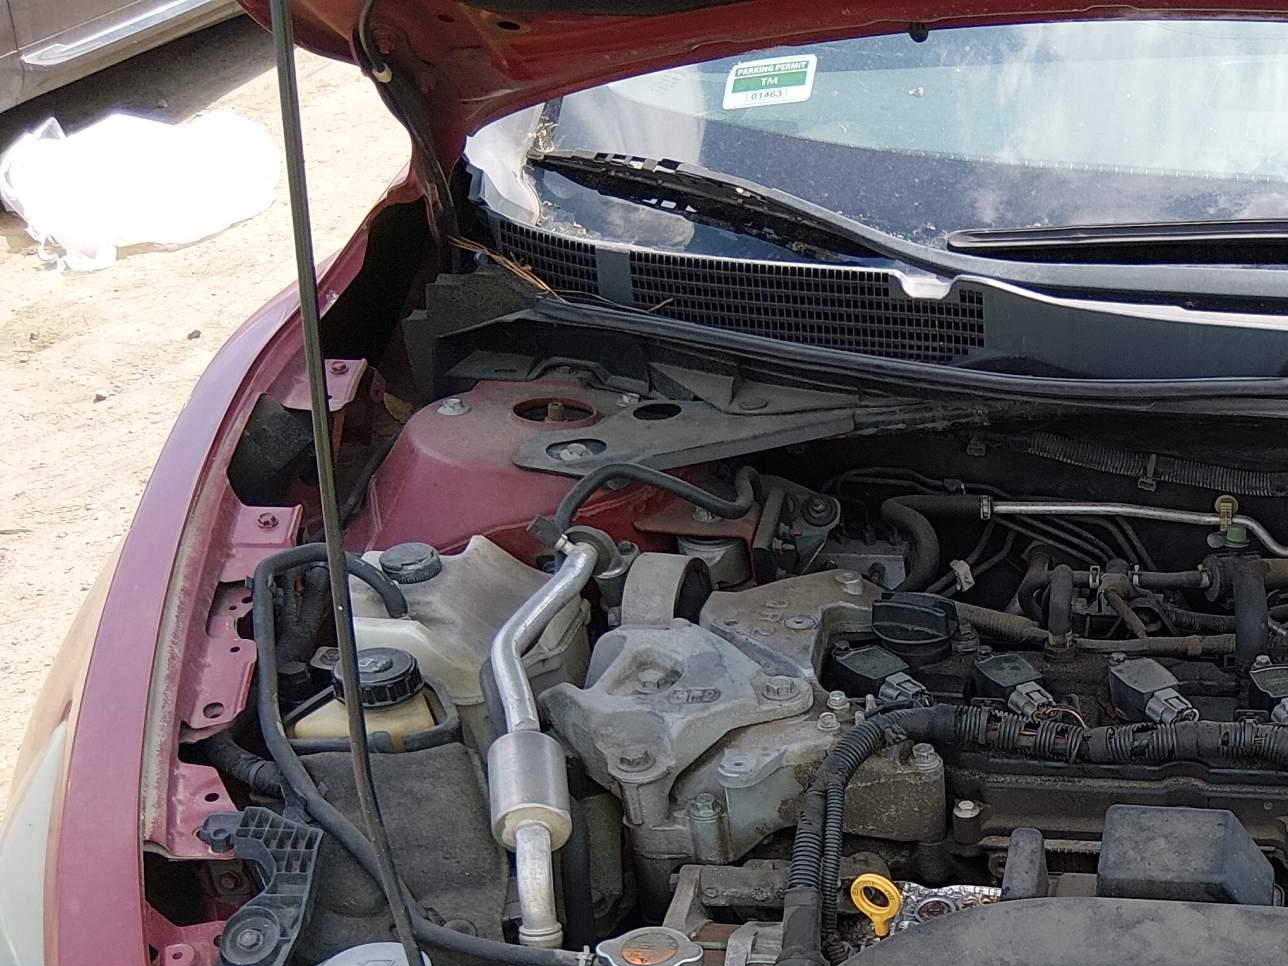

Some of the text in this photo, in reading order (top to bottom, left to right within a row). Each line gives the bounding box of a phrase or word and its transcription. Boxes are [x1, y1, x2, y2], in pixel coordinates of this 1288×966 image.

[737, 61, 807, 76] PARKING PERMIT
[761, 76, 778, 86] TM
